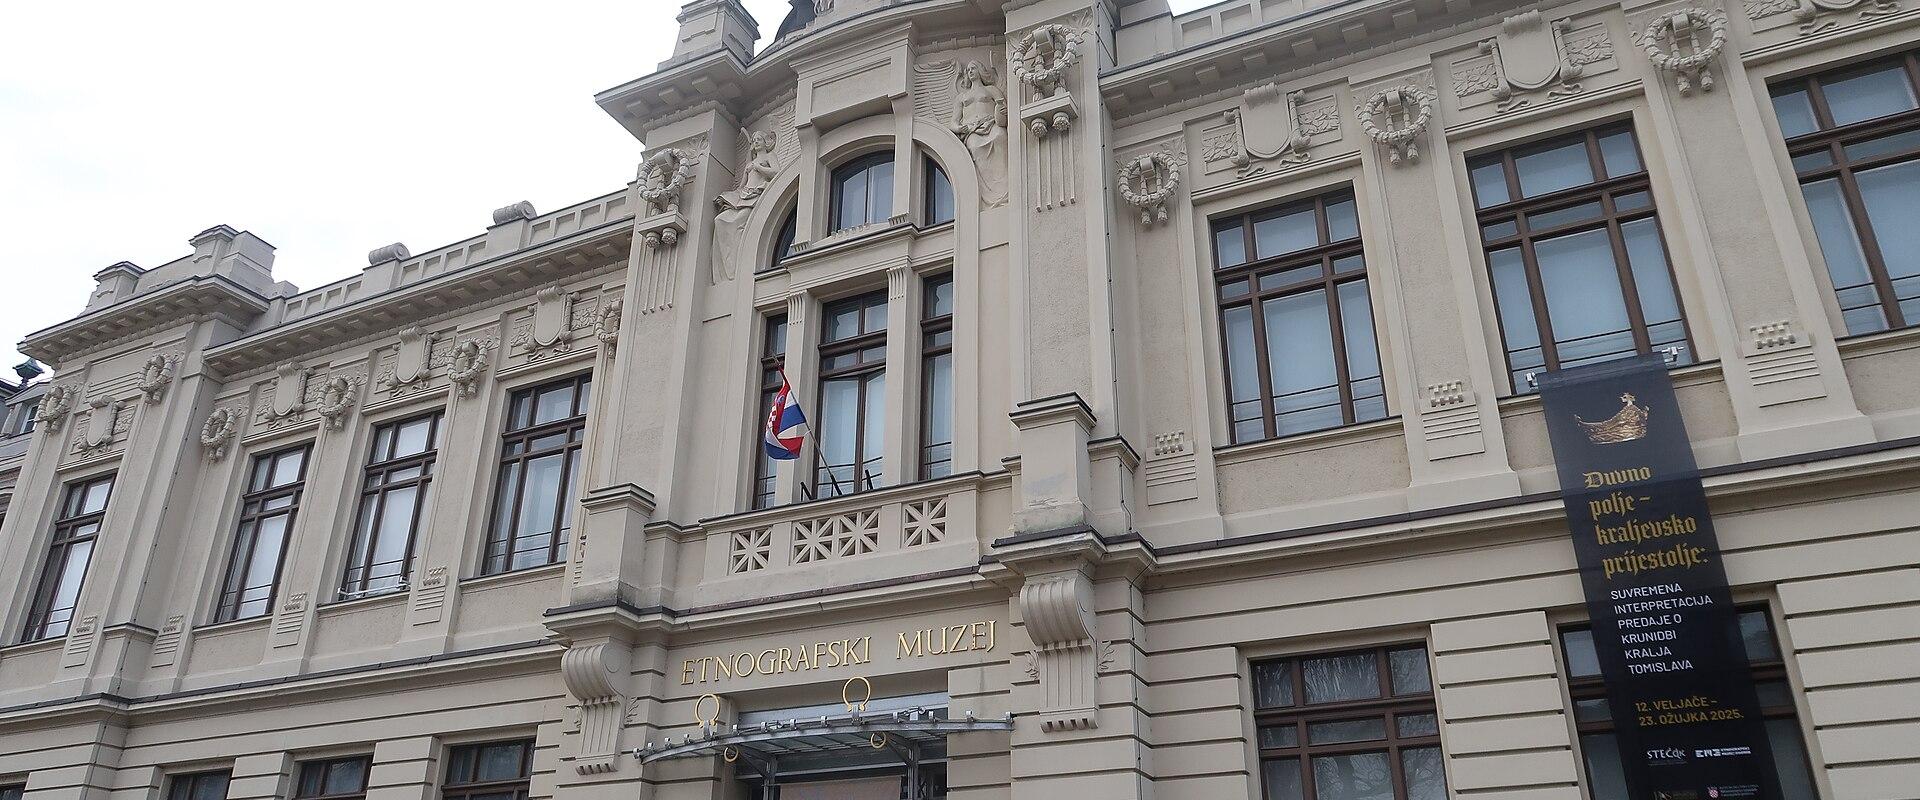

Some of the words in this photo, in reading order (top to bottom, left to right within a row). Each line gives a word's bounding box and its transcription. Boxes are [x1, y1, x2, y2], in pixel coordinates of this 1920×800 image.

[1583, 466, 1652, 489] Duvno
[1589, 491, 1635, 521] polje
[1594, 514, 1698, 546] kraljevsko
[1602, 542, 1709, 580] prijestolje:
[1611, 583, 1683, 600] SUVREMENA
[1614, 595, 1713, 615] INTERPRETACIJA
[1618, 614, 1673, 629] PREDAJE
[1673, 613, 1682, 624] O
[1621, 630, 1677, 645] KRUNIDBI
[680, 636, 872, 686] ETNOGRAFSKI
[895, 619, 997, 660] MUZEJ
[1624, 646, 1672, 660] KRALJA
[1628, 659, 1694, 675] TOMISLAVA
[1635, 702, 1652, 713] 12.
[1653, 695, 1709, 711] VELJAČE
[1640, 716, 1657, 726] 23.
[1659, 711, 1709, 725] OŽUJKA
[1710, 708, 1744, 721] 2025.
